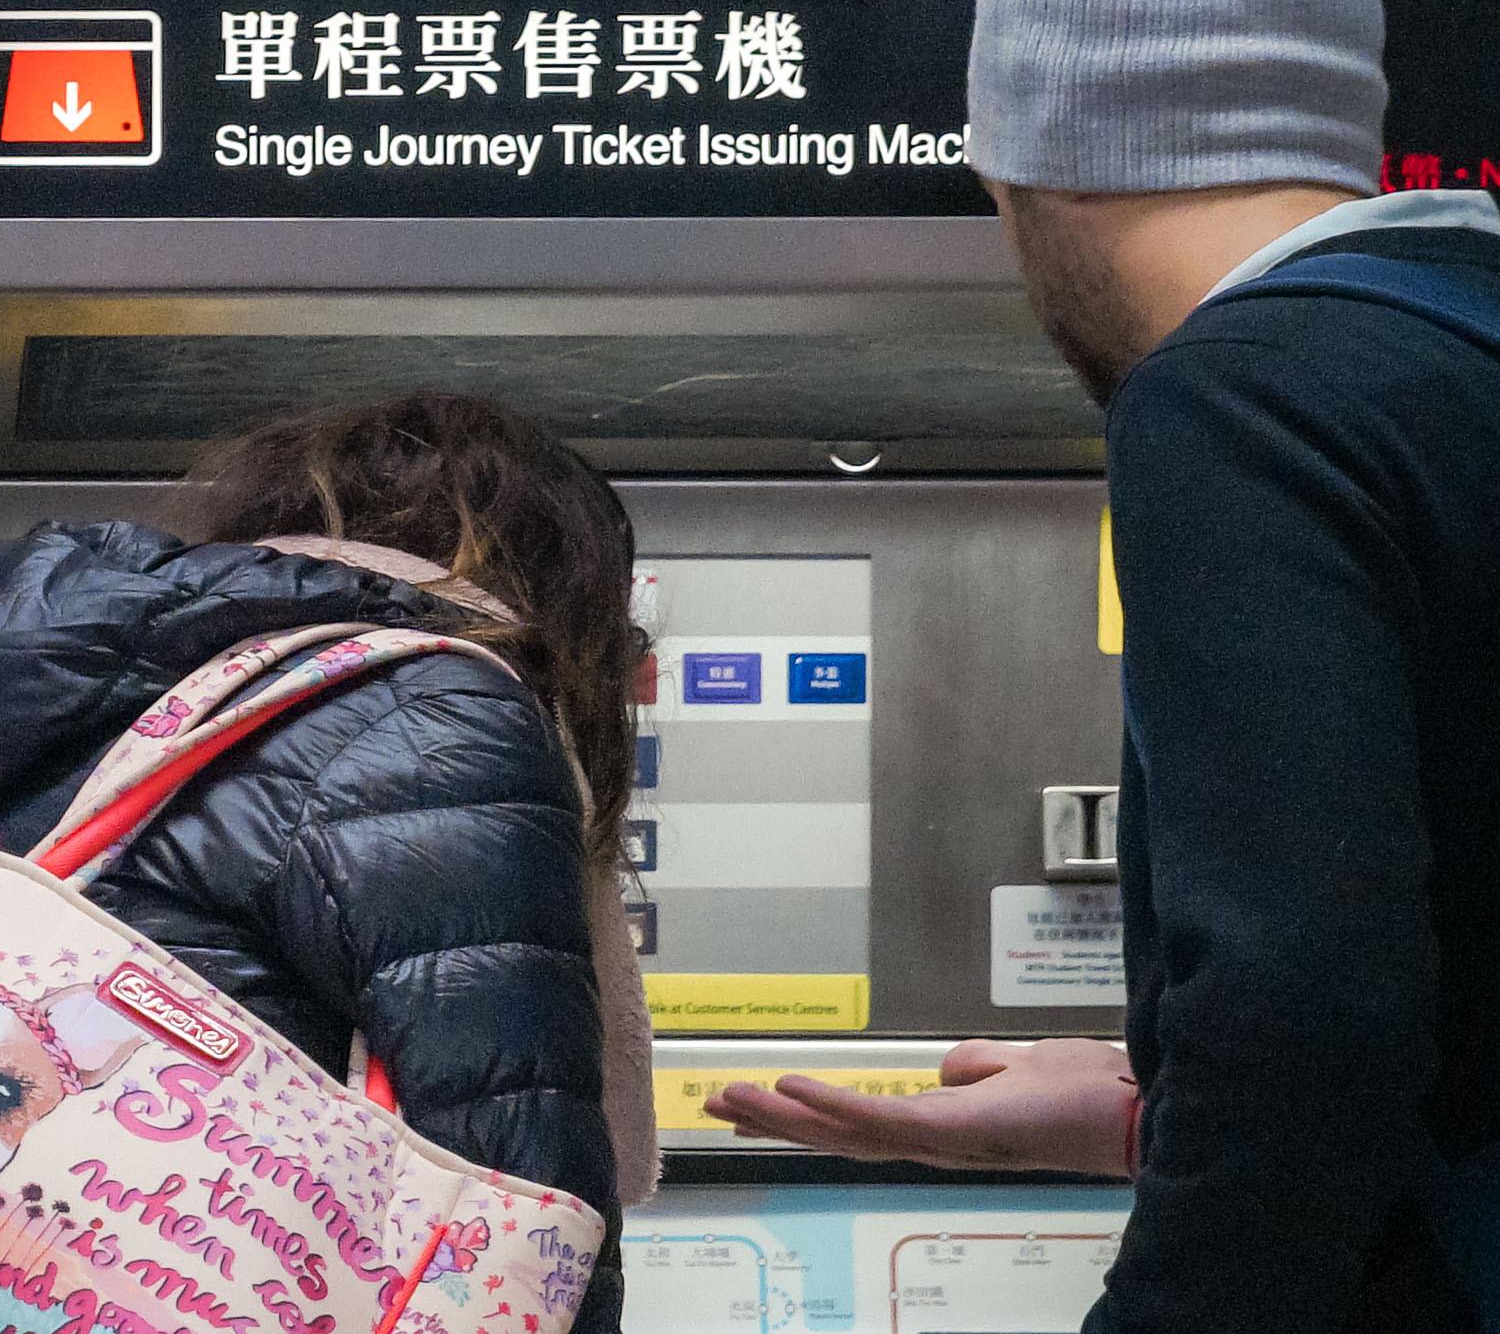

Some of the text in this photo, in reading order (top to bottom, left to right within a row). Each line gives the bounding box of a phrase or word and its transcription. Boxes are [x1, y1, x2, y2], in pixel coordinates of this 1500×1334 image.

[214, 9, 807, 102] 單程票售票機
[214, 125, 352, 176] Single
[364, 125, 541, 176] Journey
[554, 125, 685, 167] Ticket
[698, 125, 855, 176] Issuing
[67, 1218, 122, 1267] is
[68, 1158, 236, 1281] when
[199, 1167, 328, 1302] times
